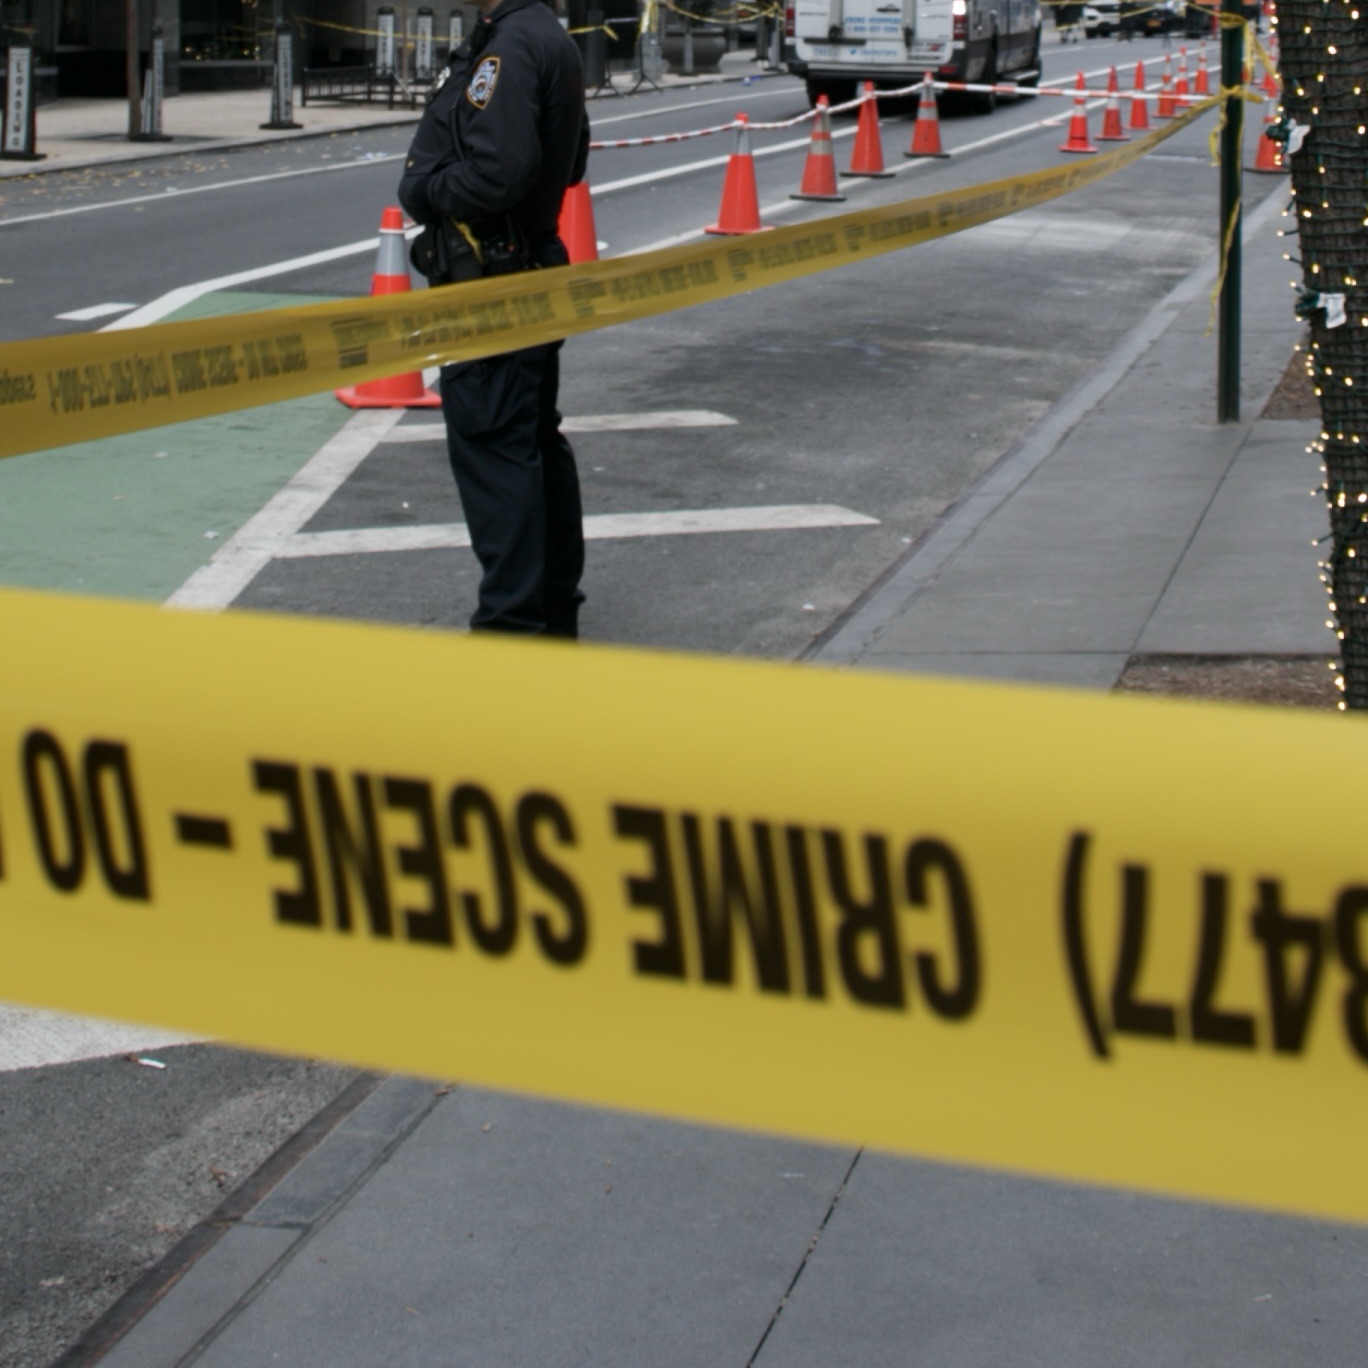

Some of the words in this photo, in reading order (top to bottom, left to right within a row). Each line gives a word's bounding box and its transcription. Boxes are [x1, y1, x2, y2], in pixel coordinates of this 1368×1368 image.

[11, 61, 23, 147] LOADING
[21, 728, 153, 905] DO
[248, 757, 590, 969] SCENE
[609, 801, 983, 1024] CRIME
